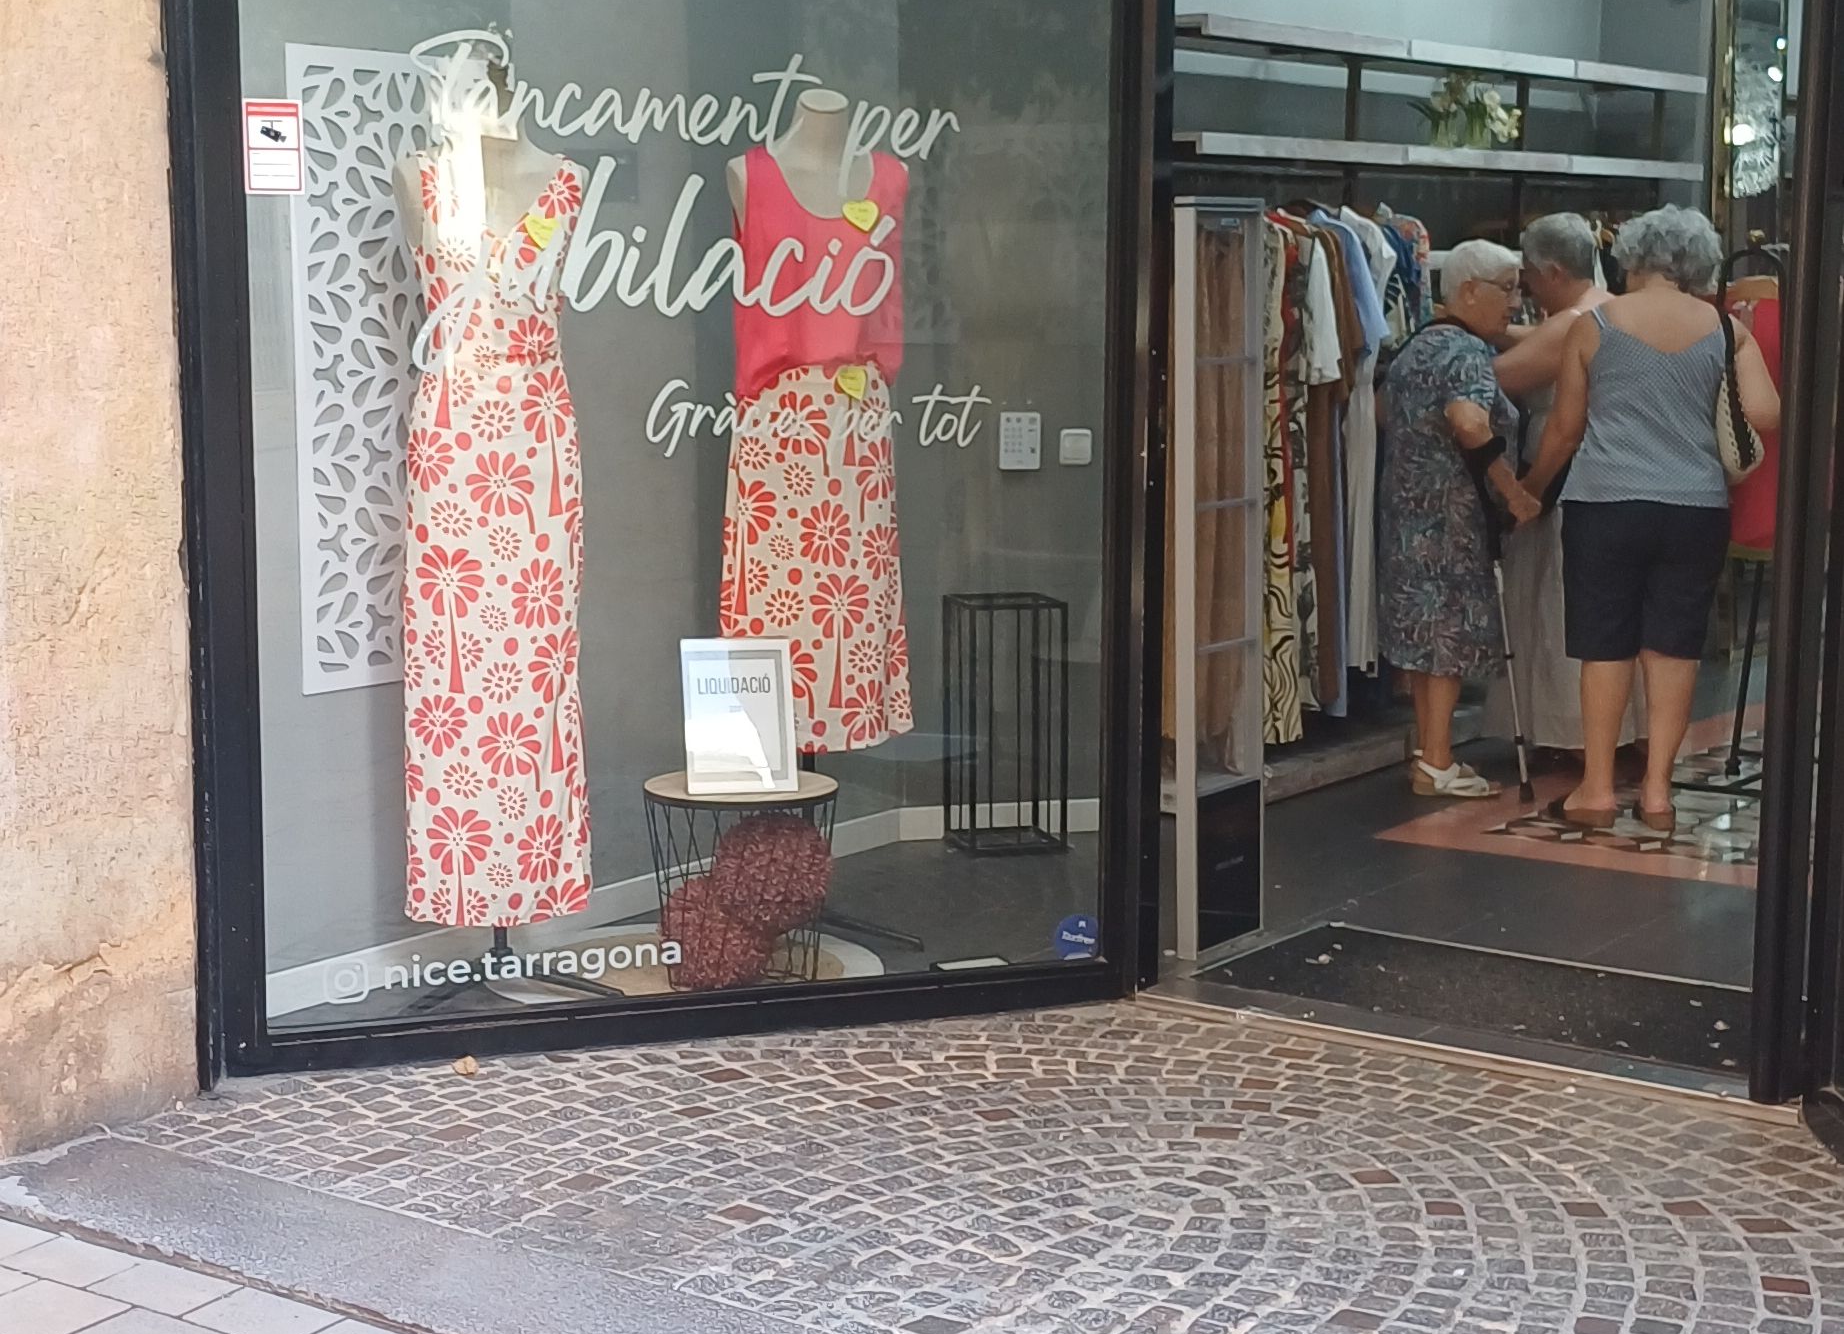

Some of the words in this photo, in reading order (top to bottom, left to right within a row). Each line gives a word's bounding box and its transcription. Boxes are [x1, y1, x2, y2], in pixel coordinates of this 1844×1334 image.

[410, 29, 823, 150] Tancament
[838, 99, 961, 198] per
[828, 404, 903, 475] per
[911, 383, 992, 447] tot
[697, 673, 771, 695] LIQUIDACIÓ
[384, 940, 682, 990] nice.tarragona
